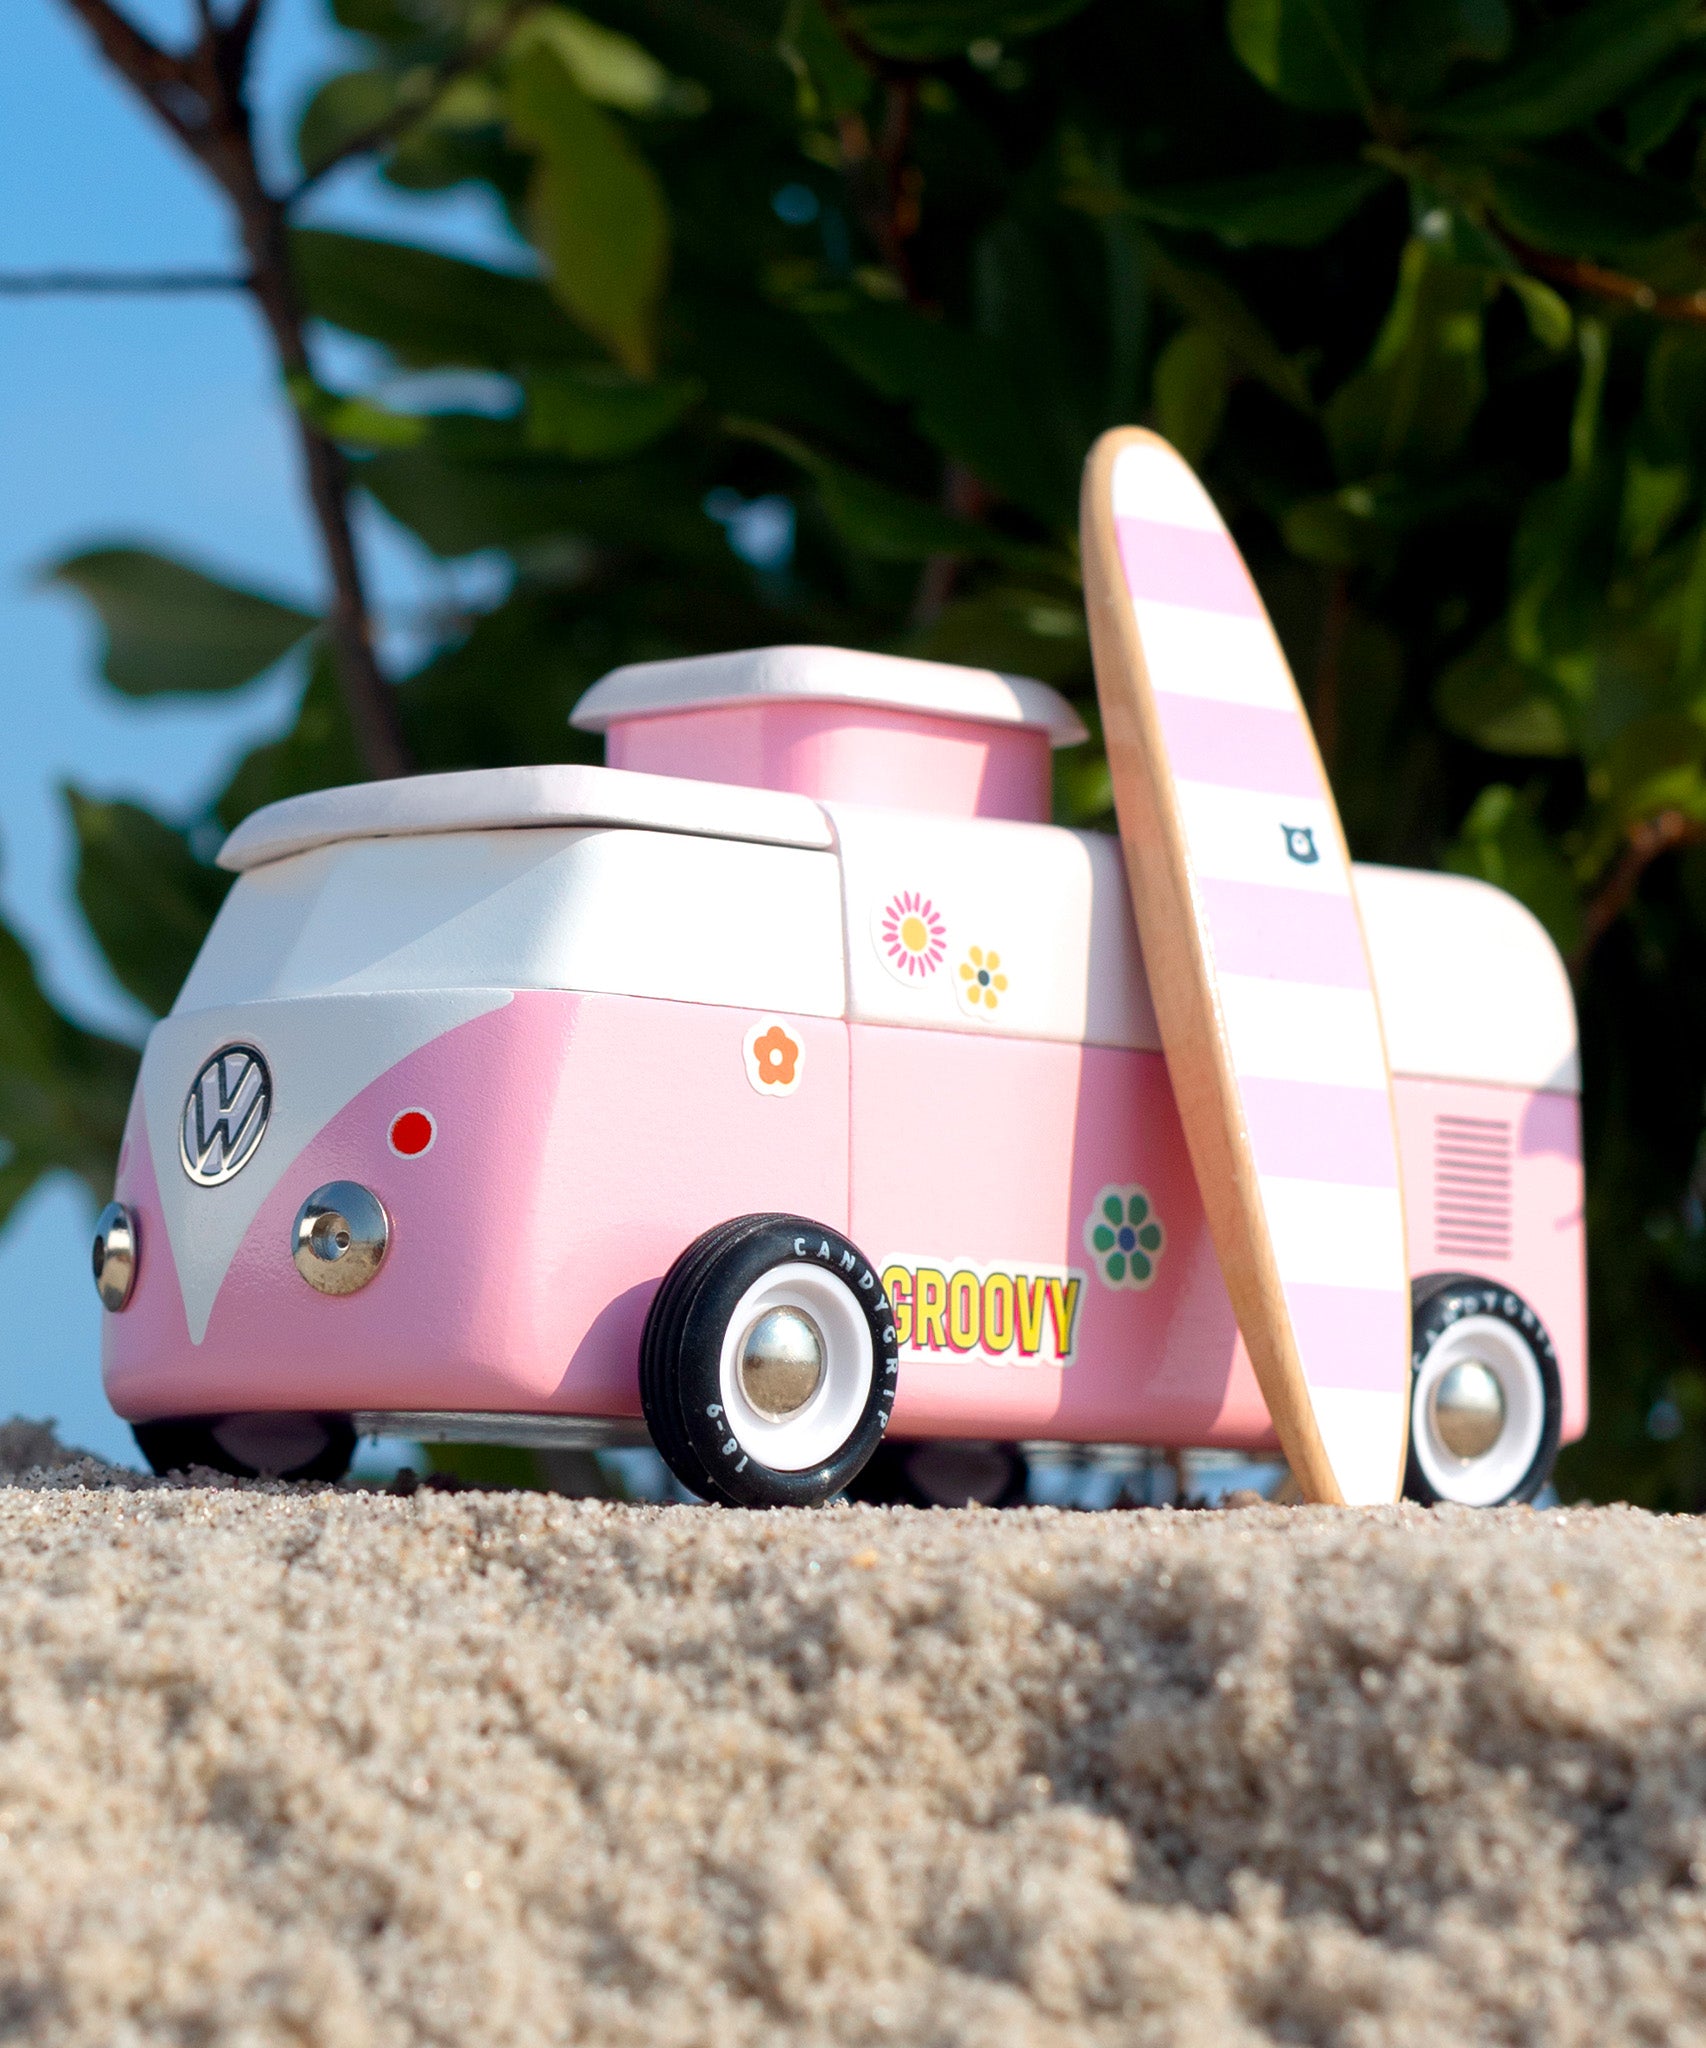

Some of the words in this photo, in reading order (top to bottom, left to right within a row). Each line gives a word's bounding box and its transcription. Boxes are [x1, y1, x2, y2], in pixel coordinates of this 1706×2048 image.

[181, 1044, 271, 1185] VW
[793, 1237, 899, 1428] CANDYGRIP
[882, 1264, 1080, 1359] GROOVY
[706, 1403, 748, 1473] 18-9
